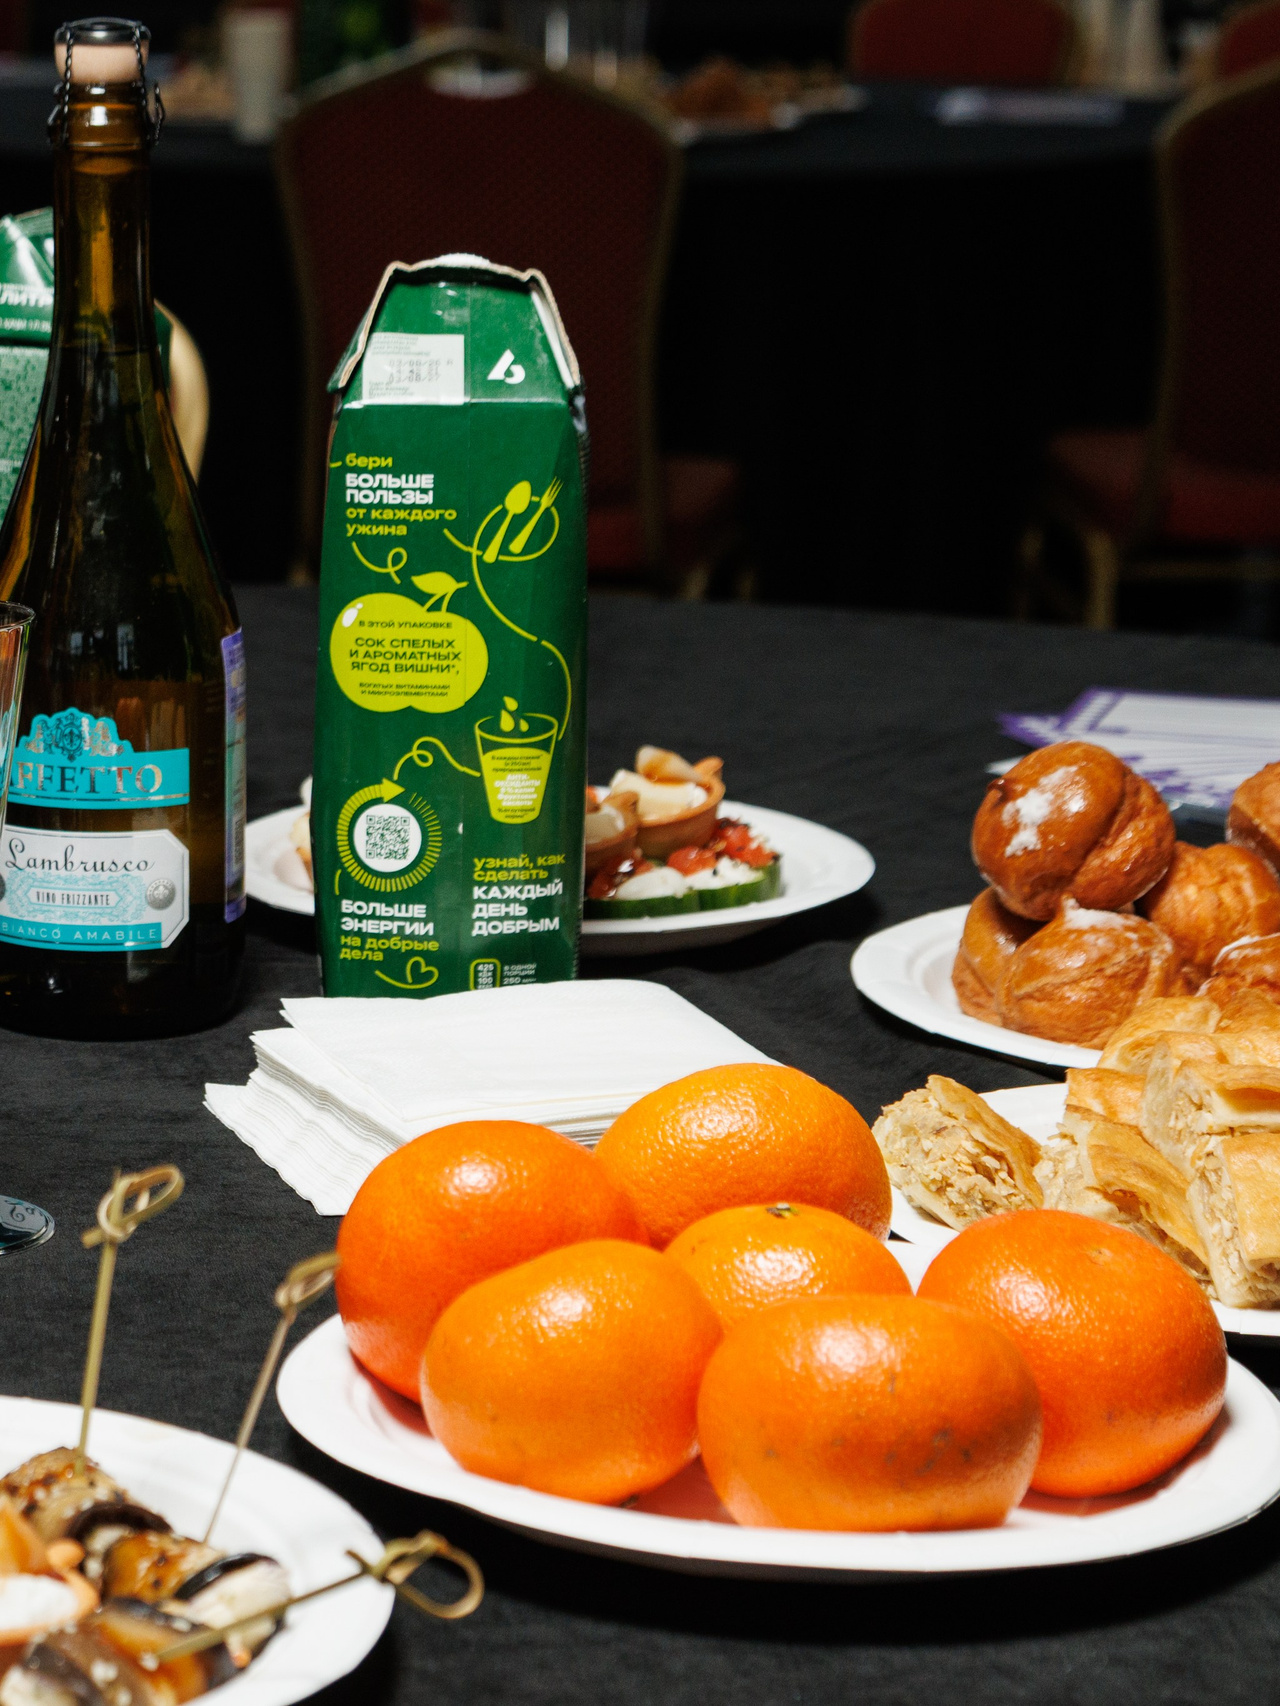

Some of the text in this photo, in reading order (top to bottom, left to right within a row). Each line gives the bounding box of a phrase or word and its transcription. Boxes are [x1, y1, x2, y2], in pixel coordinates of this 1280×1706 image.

[346, 453, 393, 470] бери
[345, 473, 434, 488] БОЛЬШЕ
[345, 489, 434, 504] ПОЛЬЗЫ
[346, 508, 458, 522] от каждого
[346, 523, 407, 536] ужина
[368, 620, 395, 629] ЭТОЙ
[398, 621, 452, 629] УПАКОВКЕ
[355, 637, 455, 649] СОК СПЕЛЫХ
[349, 649, 462, 661] И АРОМАТНЫХ
[351, 661, 390, 673] ЯГОД
[5, 837, 156, 872] Lambrusco
[473, 854, 566, 870] узнай, как
[473, 870, 549, 883] сделать
[36, 890, 111, 906] VINO FRIZZANTE
[472, 879, 564, 901] КАЖДЫЙ
[341, 899, 427, 918] БОЛЬШЕ
[471, 903, 528, 919] ДЕНЬ
[2, 920, 157, 941] BIANCO AMABILE
[341, 917, 434, 936] ЭНЕРГИИ
[471, 917, 560, 937] ДОБРЫМ
[341, 935, 440, 952] на добрые
[340, 947, 384, 962] дела
